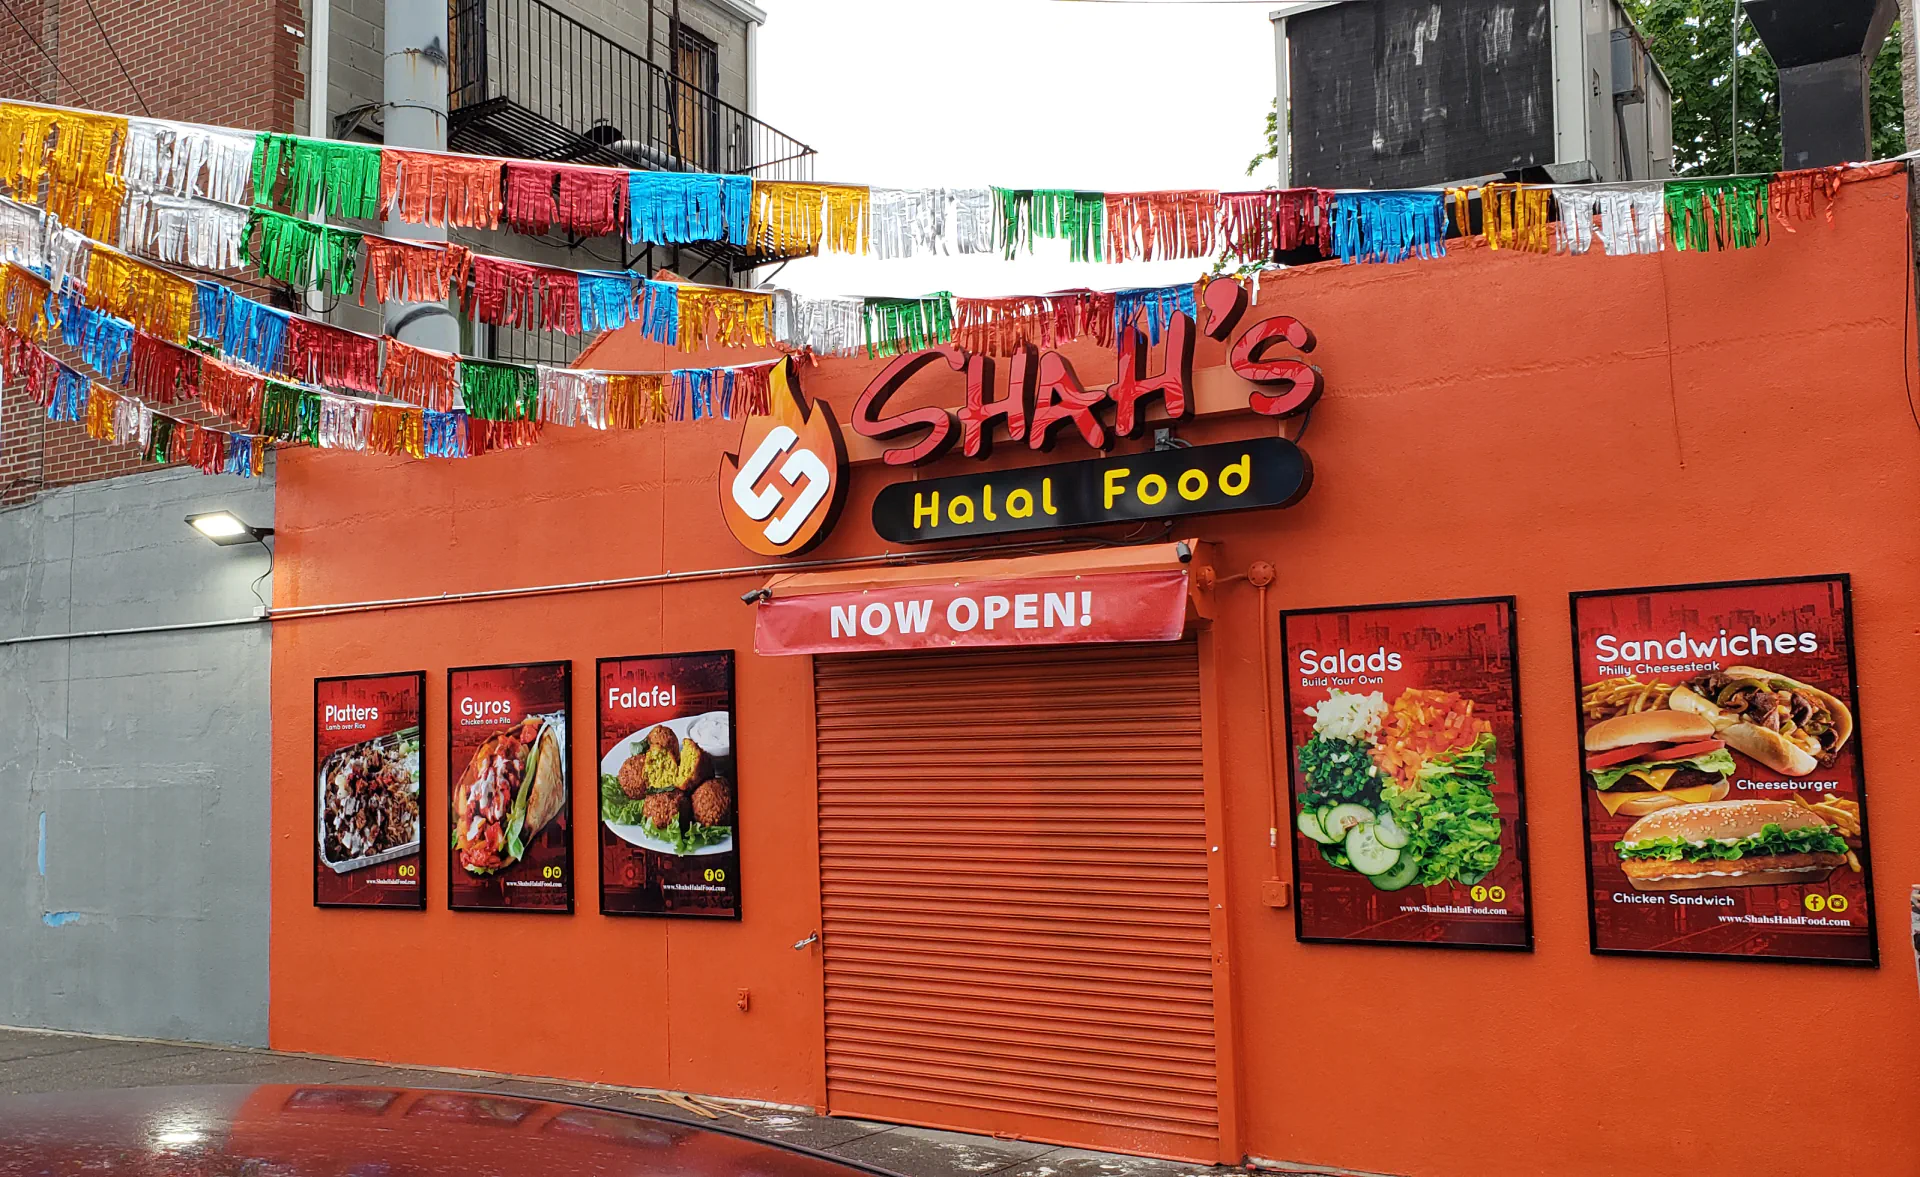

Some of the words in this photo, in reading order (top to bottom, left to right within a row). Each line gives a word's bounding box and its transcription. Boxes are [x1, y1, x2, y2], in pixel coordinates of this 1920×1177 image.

[851, 278, 1322, 465] SHAH'S
[913, 476, 1057, 530] Halal
[1103, 454, 1251, 510] Food
[830, 599, 934, 638] NOW
[946, 591, 1092, 632] OPEN!
[1595, 627, 1818, 663] Sandwiches
[1299, 646, 1403, 675] Salads
[1599, 665, 1631, 677] Philly
[1635, 661, 1720, 675] Cheesesteak
[1302, 677, 1328, 687] Build
[1331, 676, 1355, 686] Your
[1358, 675, 1384, 685] Own
[608, 684, 676, 709] Falafel
[325, 704, 378, 722] Platters
[460, 696, 511, 719] Gyros
[460, 718, 485, 726] Chicken
[1736, 779, 1838, 792] Cheeseburger
[1613, 892, 1665, 905] Chicken
[1669, 893, 1735, 906] Sandwich
[1399, 904, 1508, 915] www.ShahsHalalFood.com
[1717, 914, 1850, 927] www.ShahsHalalFood.com
